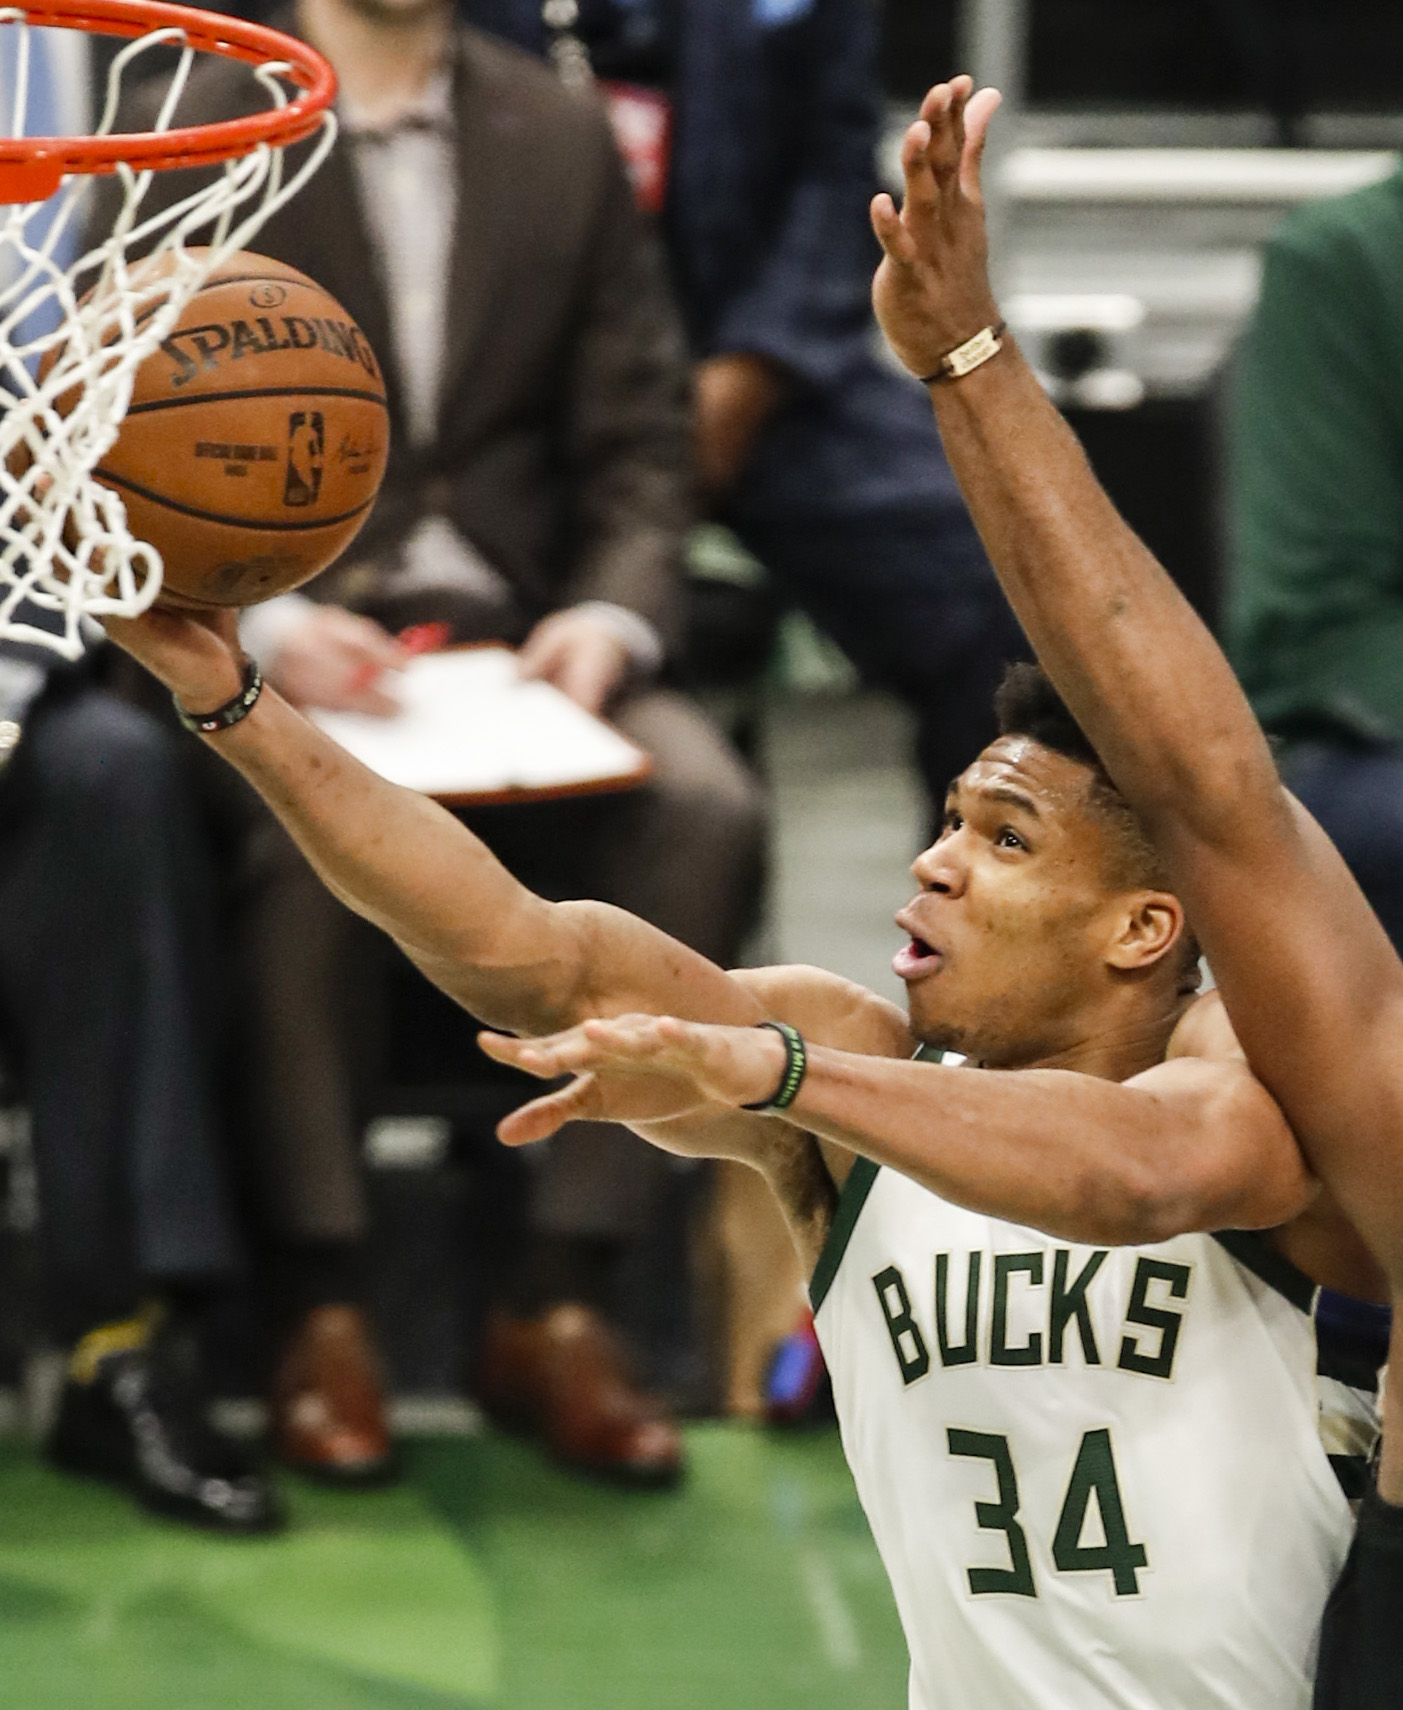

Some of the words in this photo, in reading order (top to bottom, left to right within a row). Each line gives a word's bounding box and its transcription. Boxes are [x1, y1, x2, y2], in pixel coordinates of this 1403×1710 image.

[160, 316, 381, 388] SPALDING
[870, 1247, 1196, 1388] BUCKS
[945, 1425, 1152, 1601] 34
